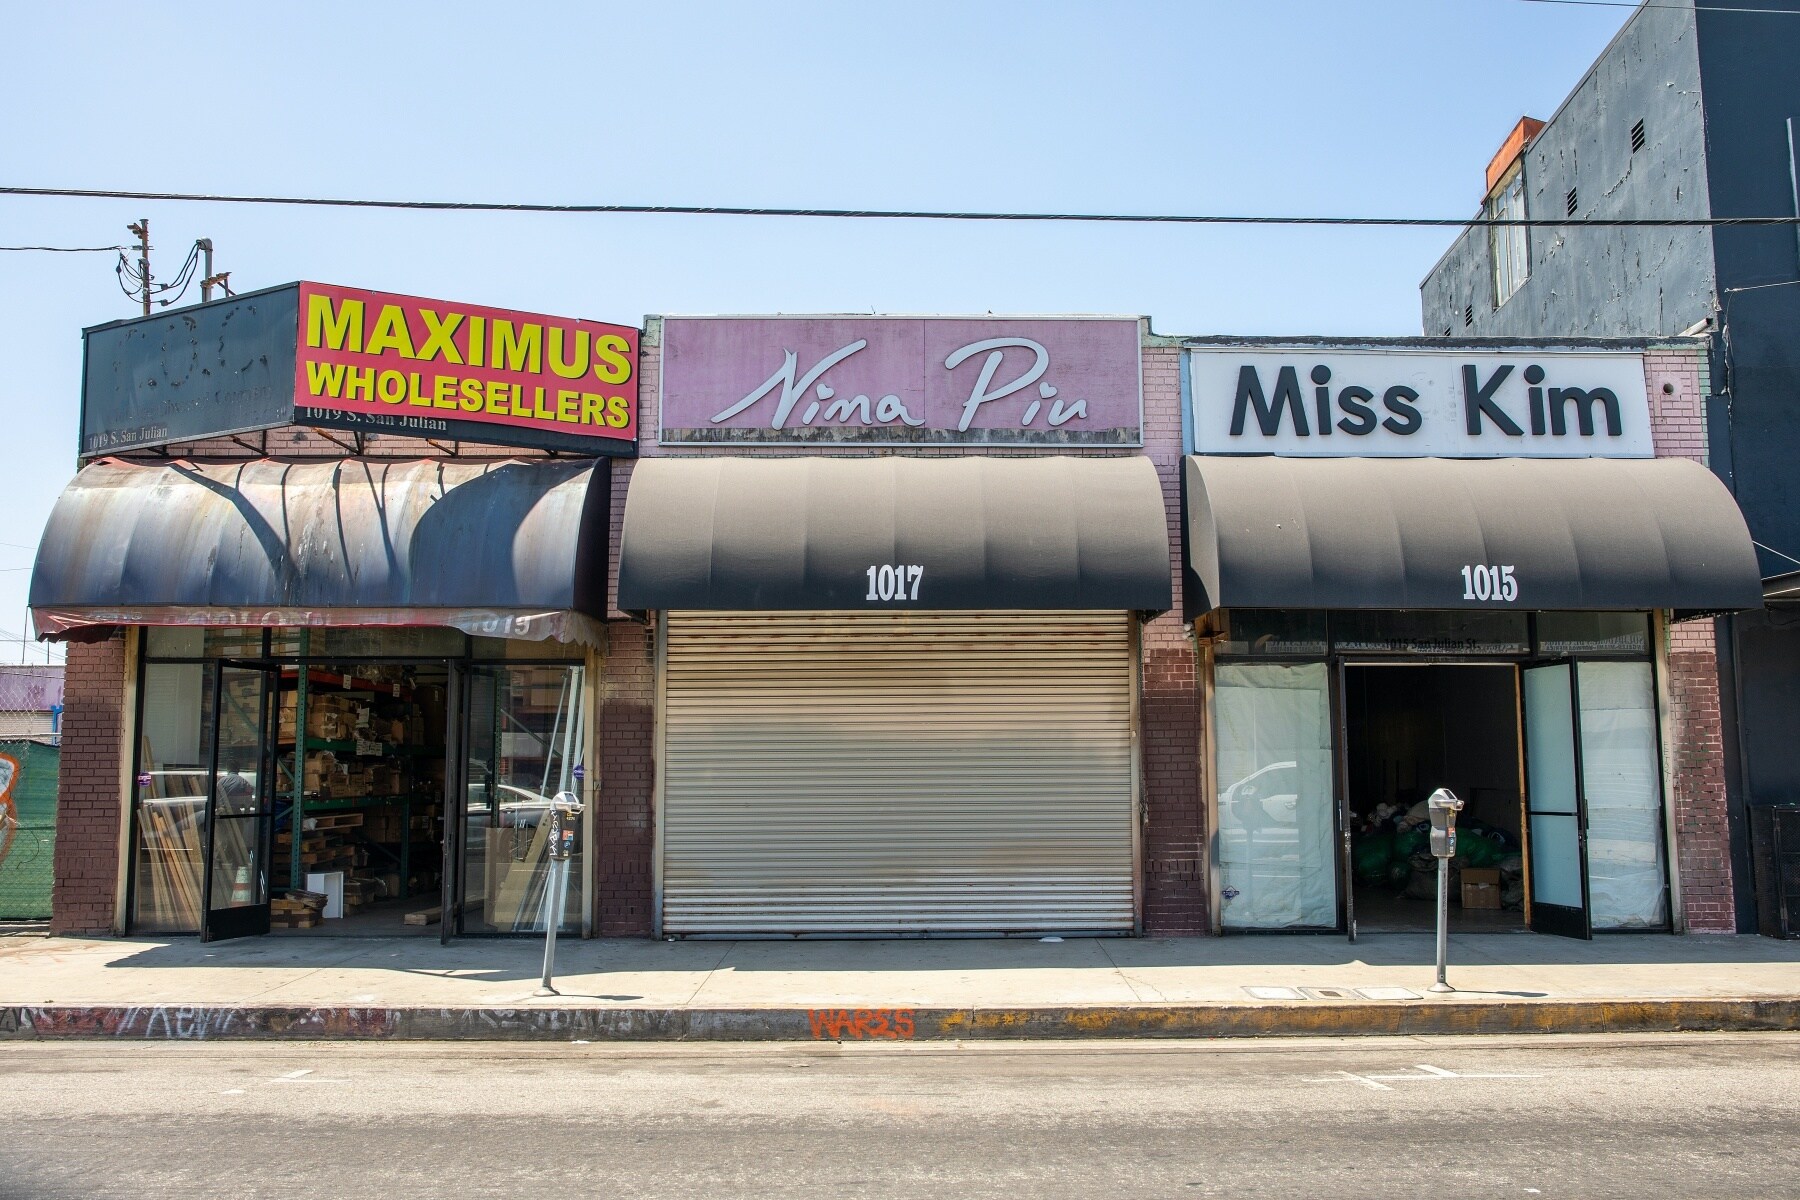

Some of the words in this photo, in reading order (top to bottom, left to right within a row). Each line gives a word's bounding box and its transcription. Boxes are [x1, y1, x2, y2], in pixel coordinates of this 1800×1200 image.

[306, 293, 632, 385] MAXIMUS
[306, 360, 631, 429] WHOLESELLERS
[1229, 364, 1424, 437] Miss
[1461, 364, 1623, 437] Kim
[120, 430, 137, 443] San
[139, 425, 168, 441] Julian
[305, 406, 342, 420] 1019
[365, 413, 395, 426] San
[399, 415, 447, 431] Julian
[865, 564, 924, 601] 1017
[1461, 564, 1518, 602] 1015
[1385, 638, 1409, 649] 1015
[1411, 638, 1431, 649] San
[1434, 637, 1464, 649] Julian
